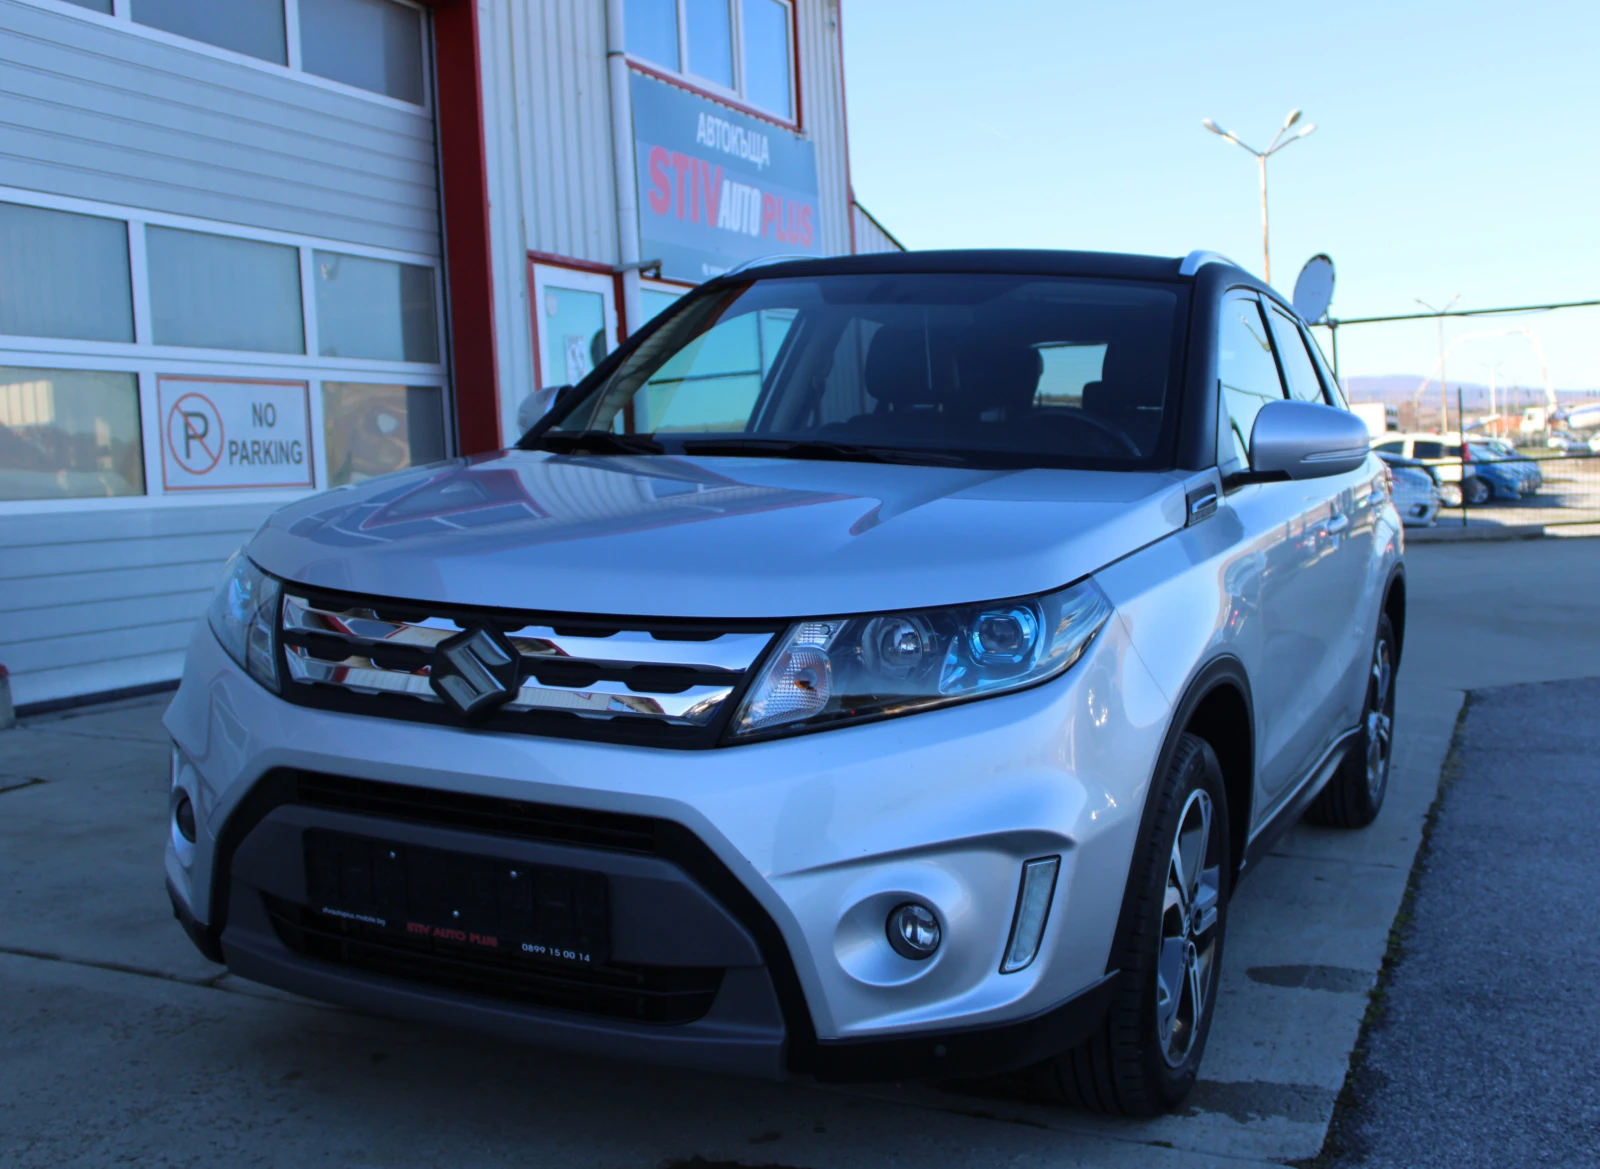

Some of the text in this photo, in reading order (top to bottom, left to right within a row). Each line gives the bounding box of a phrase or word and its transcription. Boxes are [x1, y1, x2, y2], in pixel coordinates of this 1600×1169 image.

[696, 112, 770, 171] АВТОКЪЩА
[252, 402, 276, 428] NO
[228, 439, 303, 465] PARKING
[433, 927, 467, 942] AUTO
[469, 932, 498, 948] PLUS
[521, 943, 591, 963] 0899 15 00 14
